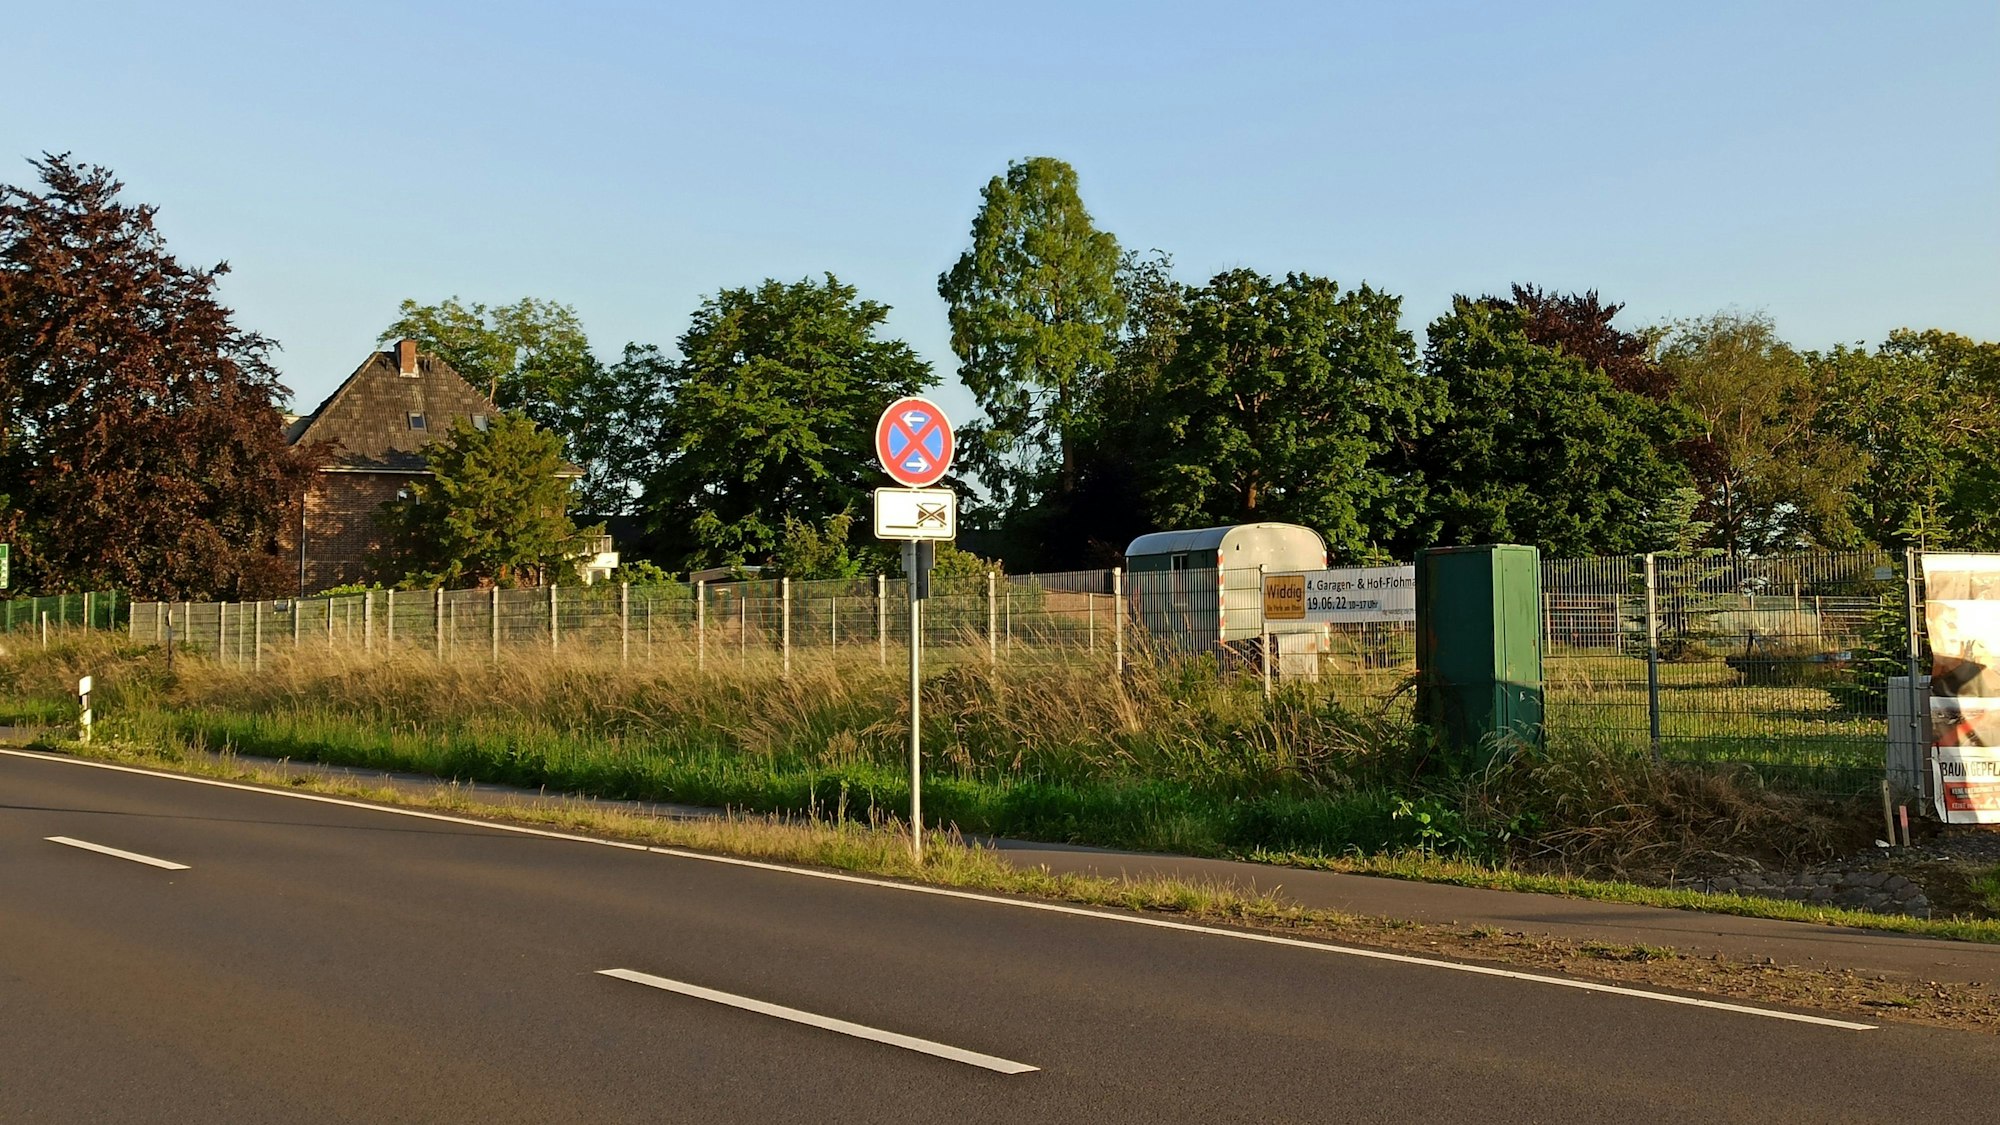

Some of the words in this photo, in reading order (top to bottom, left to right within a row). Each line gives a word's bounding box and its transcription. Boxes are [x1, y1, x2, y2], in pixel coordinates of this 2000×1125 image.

[1307, 580, 1315, 590] 4.
[1317, 580, 1354, 592] Garagen-
[1357, 578, 1365, 589] &
[1267, 584, 1302, 602] Widdig
[1307, 596, 1347, 610] 19.06.22
[1367, 600, 1379, 609] Uhr
